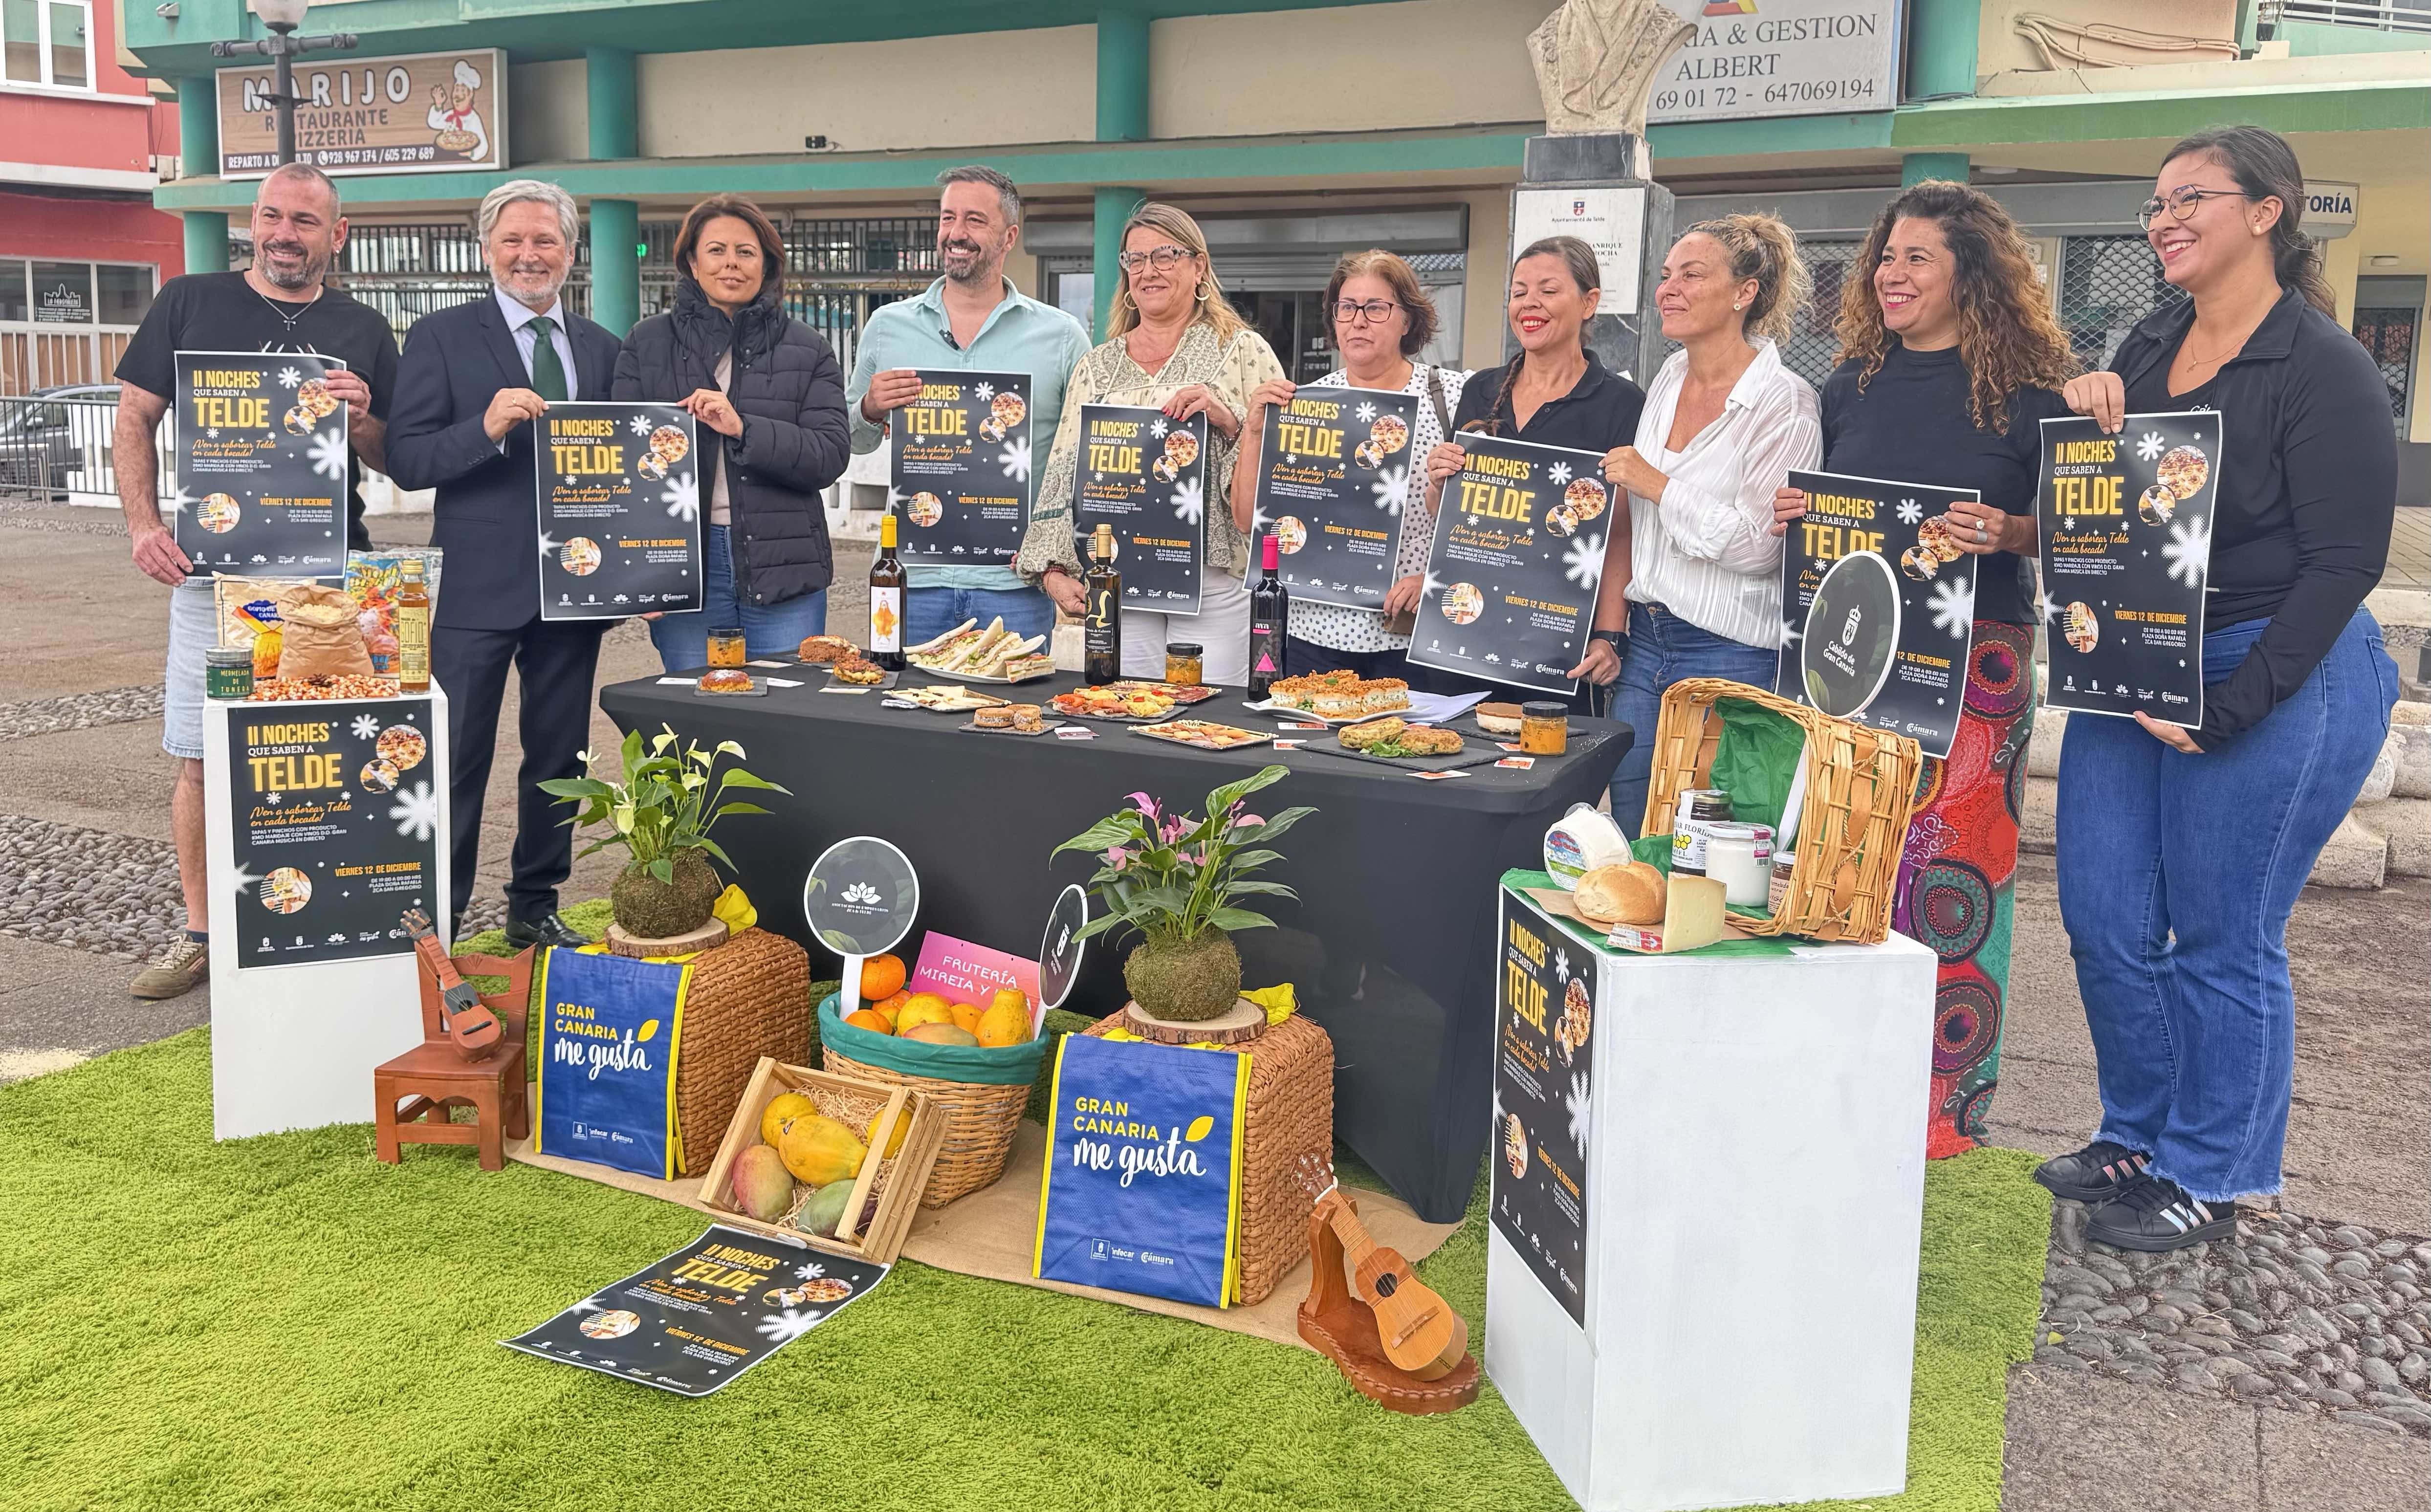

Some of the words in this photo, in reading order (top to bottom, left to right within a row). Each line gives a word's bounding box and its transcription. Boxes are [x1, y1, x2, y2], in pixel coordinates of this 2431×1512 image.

[1727, 22, 1748, 45] &
[1755, 13, 1878, 43] GESTION
[1675, 53, 1781, 81] ALBERT
[1656, 90, 1678, 110] 69
[1685, 89, 1705, 108] 01
[1714, 87, 1737, 107] 72
[1764, 78, 1874, 102] 647069194
[265, 109, 388, 131] RTAURANTE
[295, 130, 366, 148] IZZERIA
[228, 155, 263, 169] REPARTO
[264, 155, 270, 167] A
[329, 150, 342, 163] 928
[345, 150, 359, 162] 967
[362, 149, 377, 162] 174
[401, 148, 417, 161] 229
[418, 147, 435, 160] 689
[194, 370, 204, 387] II
[206, 372, 260, 388] NOCHES
[193, 398, 270, 428] TELDE
[1290, 399, 1339, 419] NOCHES
[550, 420, 560, 436] II
[562, 420, 613, 436] NOCHES
[904, 408, 967, 435] TELDE
[1092, 421, 1098, 435] II
[1100, 421, 1138, 437] NOCHES
[1295, 417, 1318, 426] SABEN
[1278, 425, 1344, 459] TELDE
[2056, 443, 2063, 464] II
[2067, 440, 2116, 462] NOCHES
[551, 446, 624, 474] TELDE
[1089, 445, 1142, 474] TELDE
[1476, 455, 1530, 480] NOCHES
[2055, 466, 2069, 475] QUE
[2071, 465, 2095, 474] SABEN
[1463, 473, 1479, 482] QUE
[1481, 475, 1506, 485] SABEN
[1460, 482, 1535, 523] TELDE
[1816, 493, 1875, 519] NOCHES
[2053, 477, 2124, 515] TELDE
[1803, 513, 1820, 524] QUE
[1822, 516, 1852, 526] SABEN
[1505, 595, 1528, 607] VIERNES
[1529, 599, 1536, 609] 12
[1539, 602, 1547, 610] DE
[1548, 603, 1578, 616] DICIEMBRE
[2115, 611, 2136, 622] VIERNES
[2138, 612, 2145, 622] 12
[2147, 613, 2155, 622] DE
[2156, 613, 2187, 624] DICIEMBRE
[1823, 648, 1837, 663] Gran
[1836, 657, 1855, 677] Canaria
[1828, 640, 1848, 660] Cabildo
[1847, 654, 1855, 665] de
[1897, 651, 1905, 660] 12
[1907, 653, 1916, 662] DE
[1916, 654, 1951, 669] DICIEMBRE
[248, 726, 260, 745] II
[264, 723, 329, 745] NOCHES
[248, 747, 270, 757] QUE
[273, 746, 304, 754] SABEN
[249, 753, 342, 791] TELDE
[327, 802, 351, 811] Telde
[263, 816, 287, 825] cada
[335, 868, 363, 877] VIERNES
[365, 866, 372, 875] 12
[386, 862, 421, 873] DICIEMBRE
[1510, 919, 1515, 944] II
[1516, 923, 1546, 968] NOCHES
[942, 956, 1017, 989] FRUTERÍA
[1509, 946, 1517, 961] QUE
[1518, 952, 1532, 972] SABEN
[1532, 966, 1536, 977] A
[920, 966, 974, 993] MIREIA
[980, 985, 990, 996] Y
[1508, 959, 1549, 1036] TELDE
[555, 1002, 595, 1020] GRAN
[554, 1019, 618, 1041] CANARIA
[554, 1036, 586, 1066] me
[588, 1028, 652, 1081] gusta
[1075, 1096, 1128, 1117] GRAN
[1073, 1117, 1159, 1141] CANARIA
[1073, 1137, 1114, 1171] me
[1118, 1126, 1207, 1188] gusta
[718, 1248, 781, 1271] NOCHES
[1140, 1251, 1174, 1265] Cámara
[672, 1259, 768, 1293] TELDE
